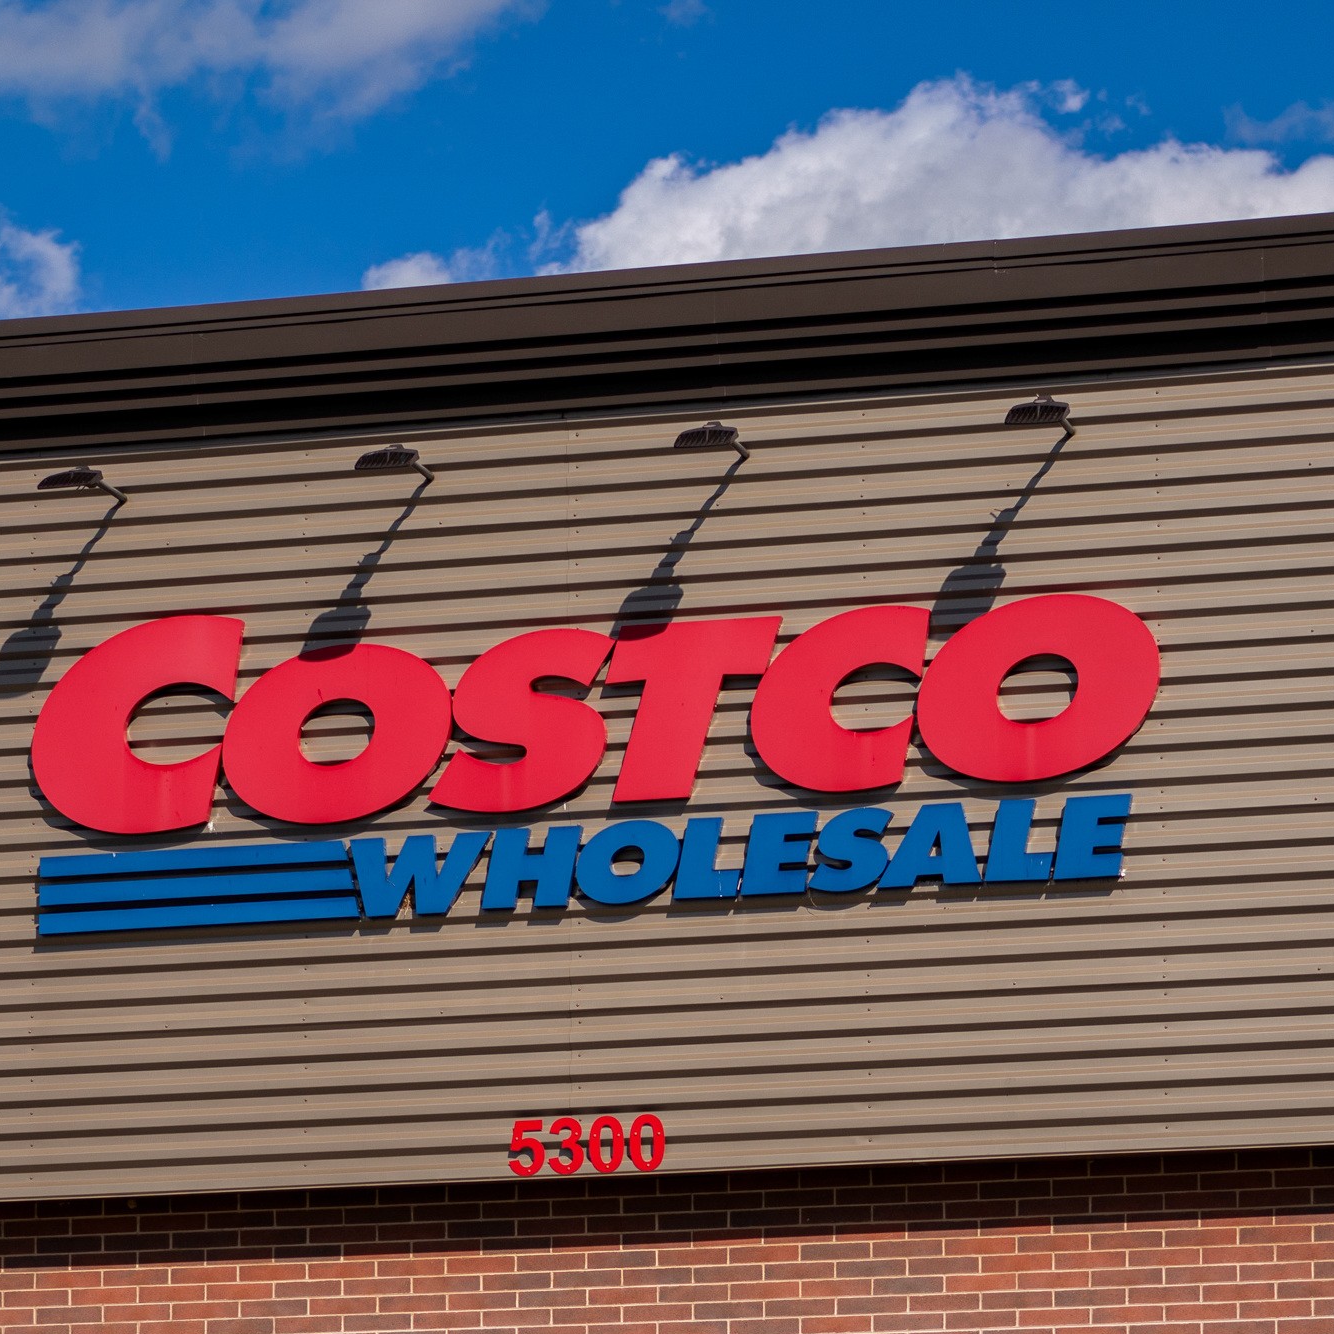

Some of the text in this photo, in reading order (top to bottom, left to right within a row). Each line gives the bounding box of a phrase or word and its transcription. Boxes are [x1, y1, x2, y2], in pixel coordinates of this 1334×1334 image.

[31, 592, 1160, 834] COSTCO
[349, 794, 1131, 918] WHOLESALE
[509, 1113, 666, 1177] 5300
